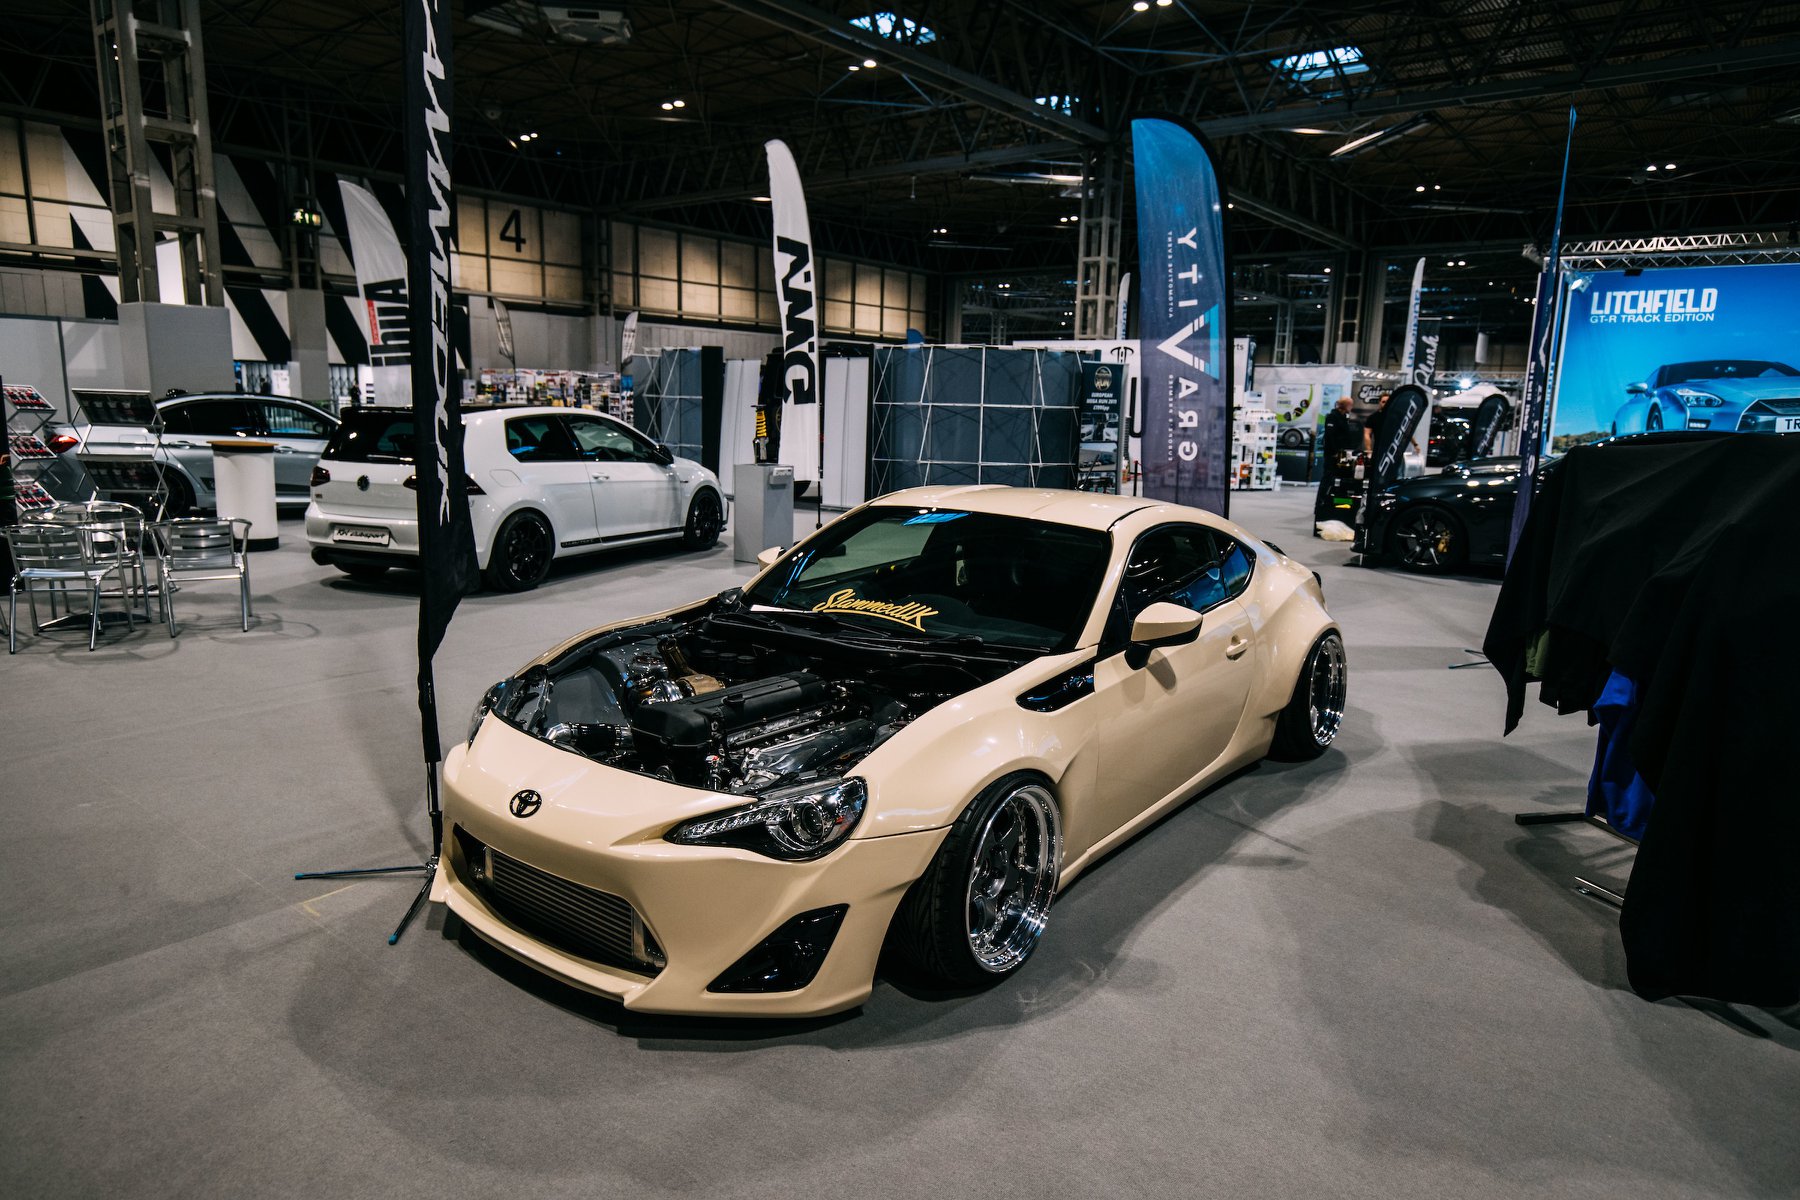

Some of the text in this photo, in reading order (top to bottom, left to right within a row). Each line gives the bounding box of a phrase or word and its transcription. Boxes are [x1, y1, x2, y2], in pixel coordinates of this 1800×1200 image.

[500, 210, 526, 253] 4
[1590, 288, 1718, 315] LITCHFIELD
[1590, 313, 1714, 324] GT-R TRACK EDITION
